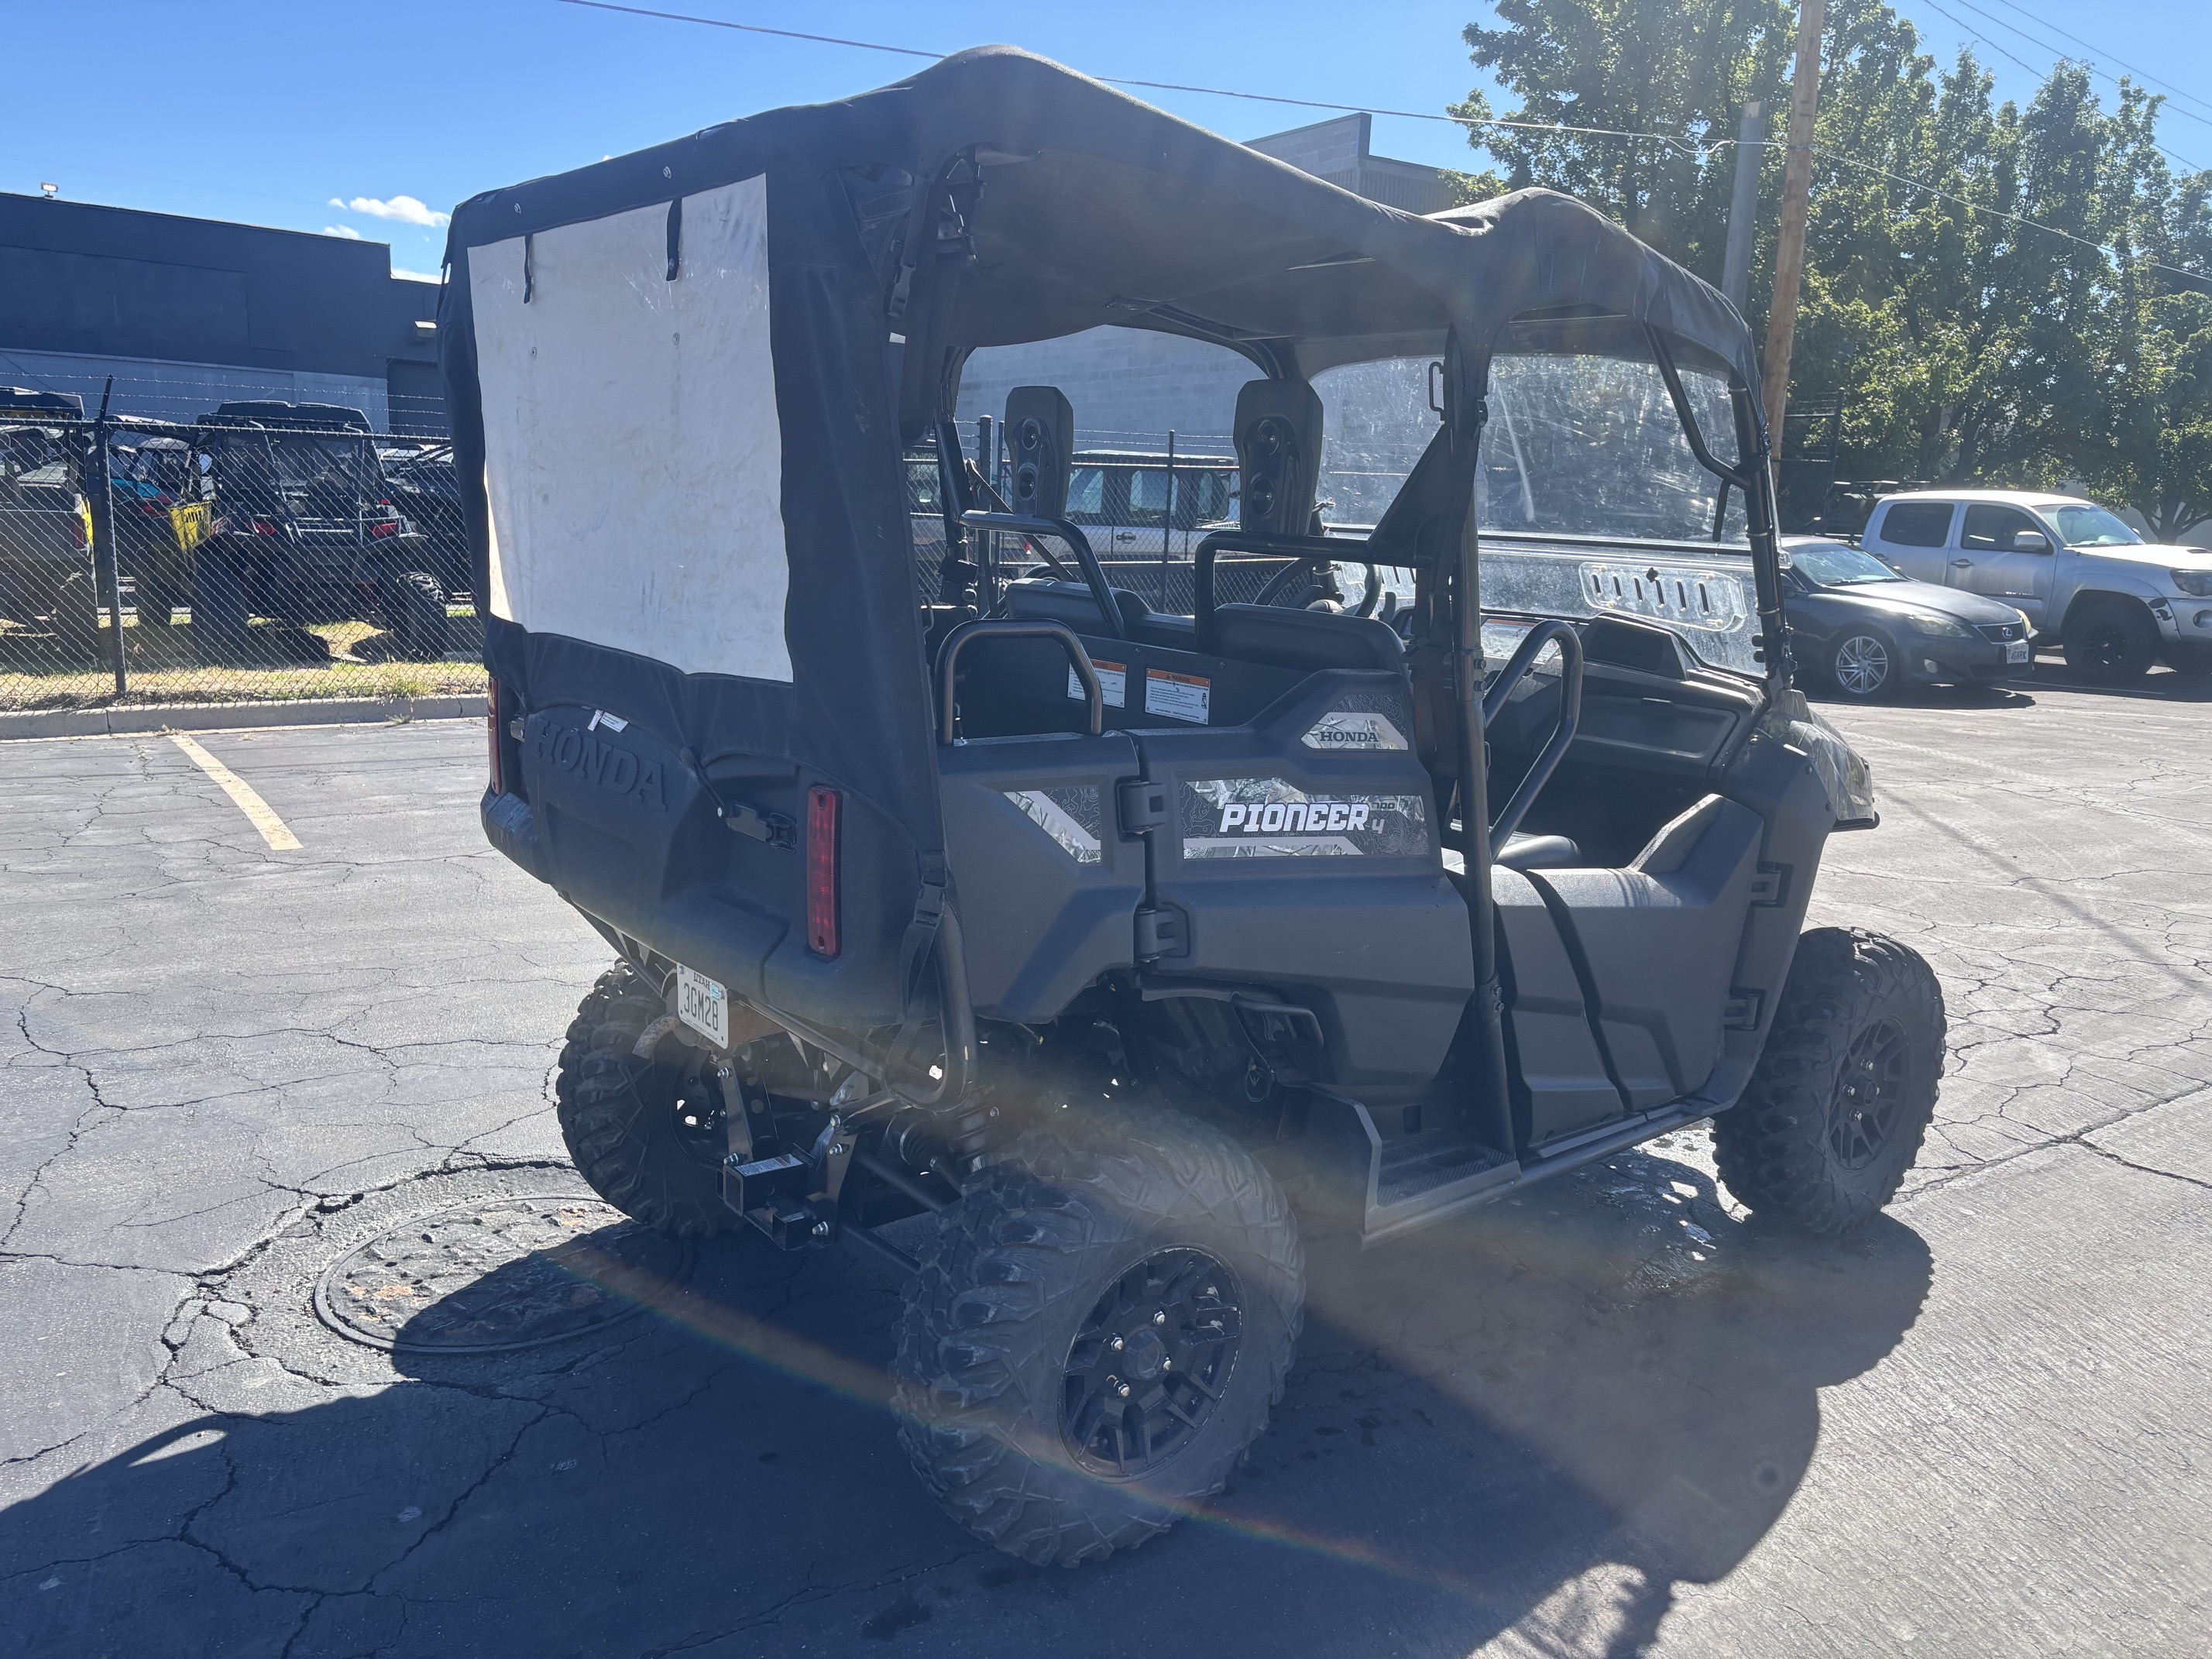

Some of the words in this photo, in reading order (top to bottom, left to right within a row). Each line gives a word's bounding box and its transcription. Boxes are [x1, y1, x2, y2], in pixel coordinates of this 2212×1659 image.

[1320, 732, 1379, 742] HONDA
[532, 718, 668, 812] HONDA
[1218, 802, 1369, 833] PIONEER
[1372, 819, 1385, 834] 4
[694, 972, 710, 991] UTAH
[684, 982, 719, 1032] 3GM28
